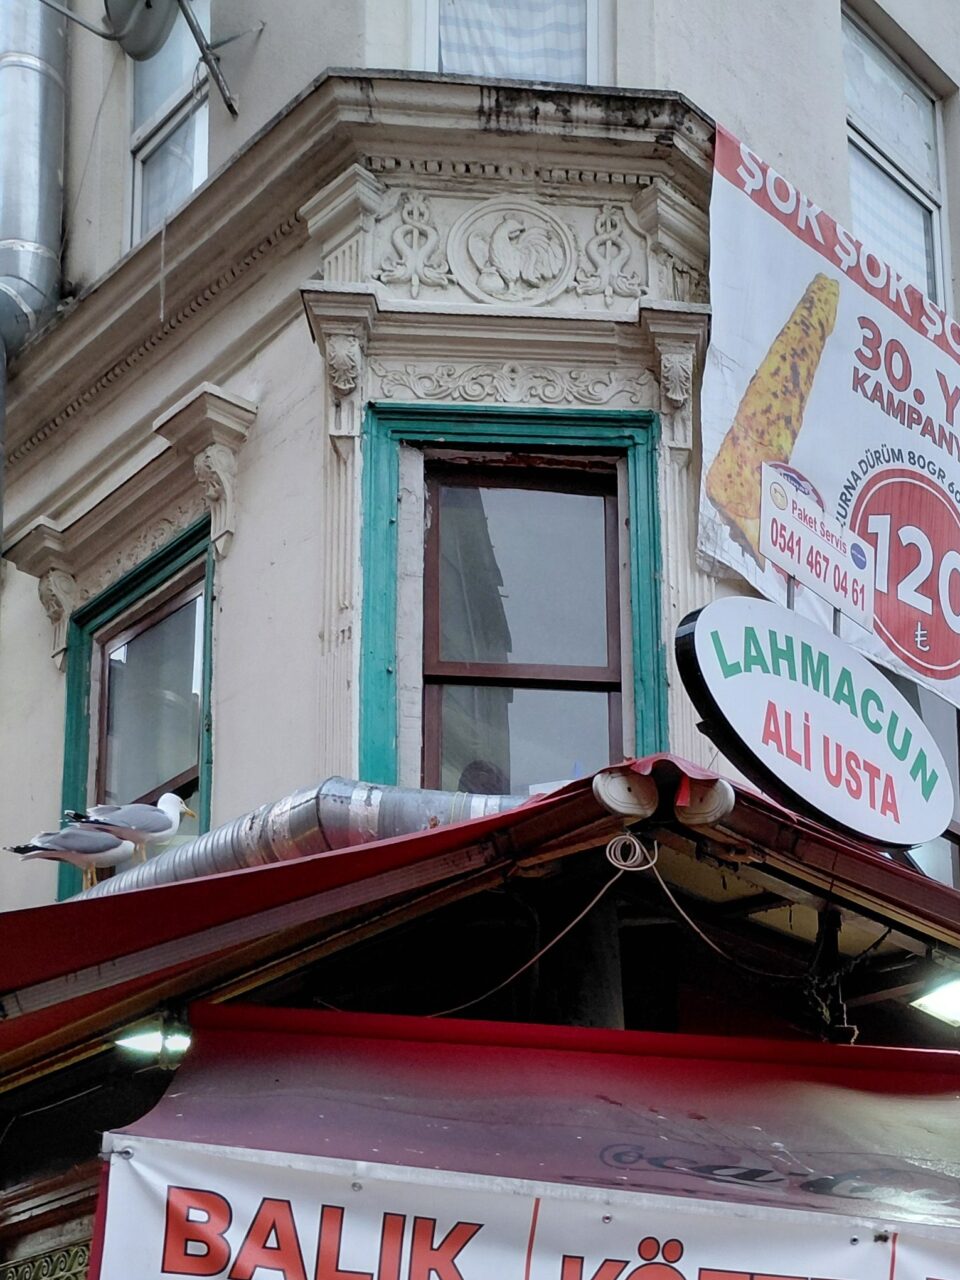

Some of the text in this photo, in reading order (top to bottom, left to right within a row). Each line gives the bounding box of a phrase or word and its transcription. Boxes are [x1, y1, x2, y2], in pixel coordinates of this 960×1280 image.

[736, 141, 825, 246] ŞOK
[833, 221, 913, 317] ŞOK
[853, 315, 926, 406] 30.
[858, 444, 904, 476] DÜRÜM
[907, 451, 946, 484] 80GR
[770, 517, 865, 611] 0541 467 04 61
[791, 499, 848, 554] Paket Servis
[710, 625, 939, 802] LAHMACUN
[761, 700, 901, 824] ALİ USTA
